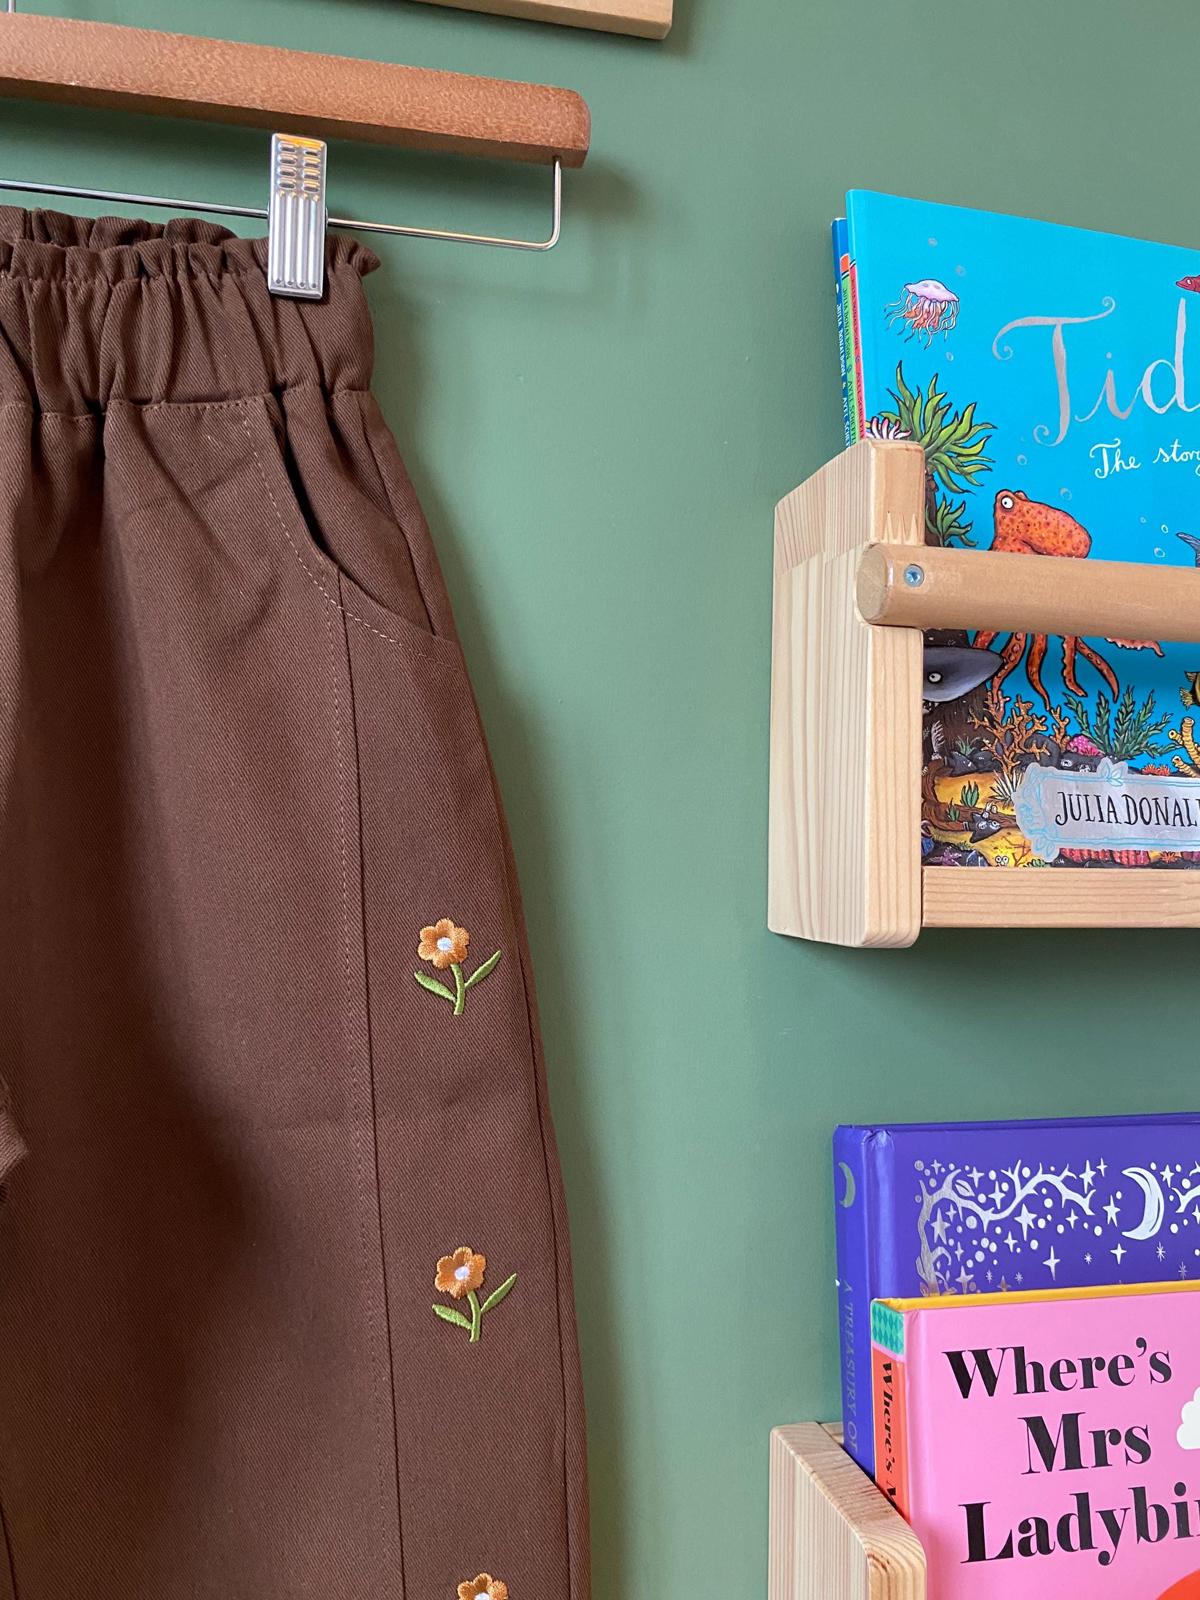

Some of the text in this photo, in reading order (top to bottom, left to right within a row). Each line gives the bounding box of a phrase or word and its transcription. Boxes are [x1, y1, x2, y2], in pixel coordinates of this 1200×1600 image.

[1089, 437, 1141, 479] The
[1055, 791, 1200, 827] JULIA DONAL
[843, 1281, 853, 1293] A
[844, 1303, 857, 1417] TREASURY
[941, 1336, 1172, 1399] Where's
[883, 1363, 896, 1474] Where's
[1017, 1411, 1152, 1475] Mrs
[957, 1481, 1200, 1566] Ladybi
